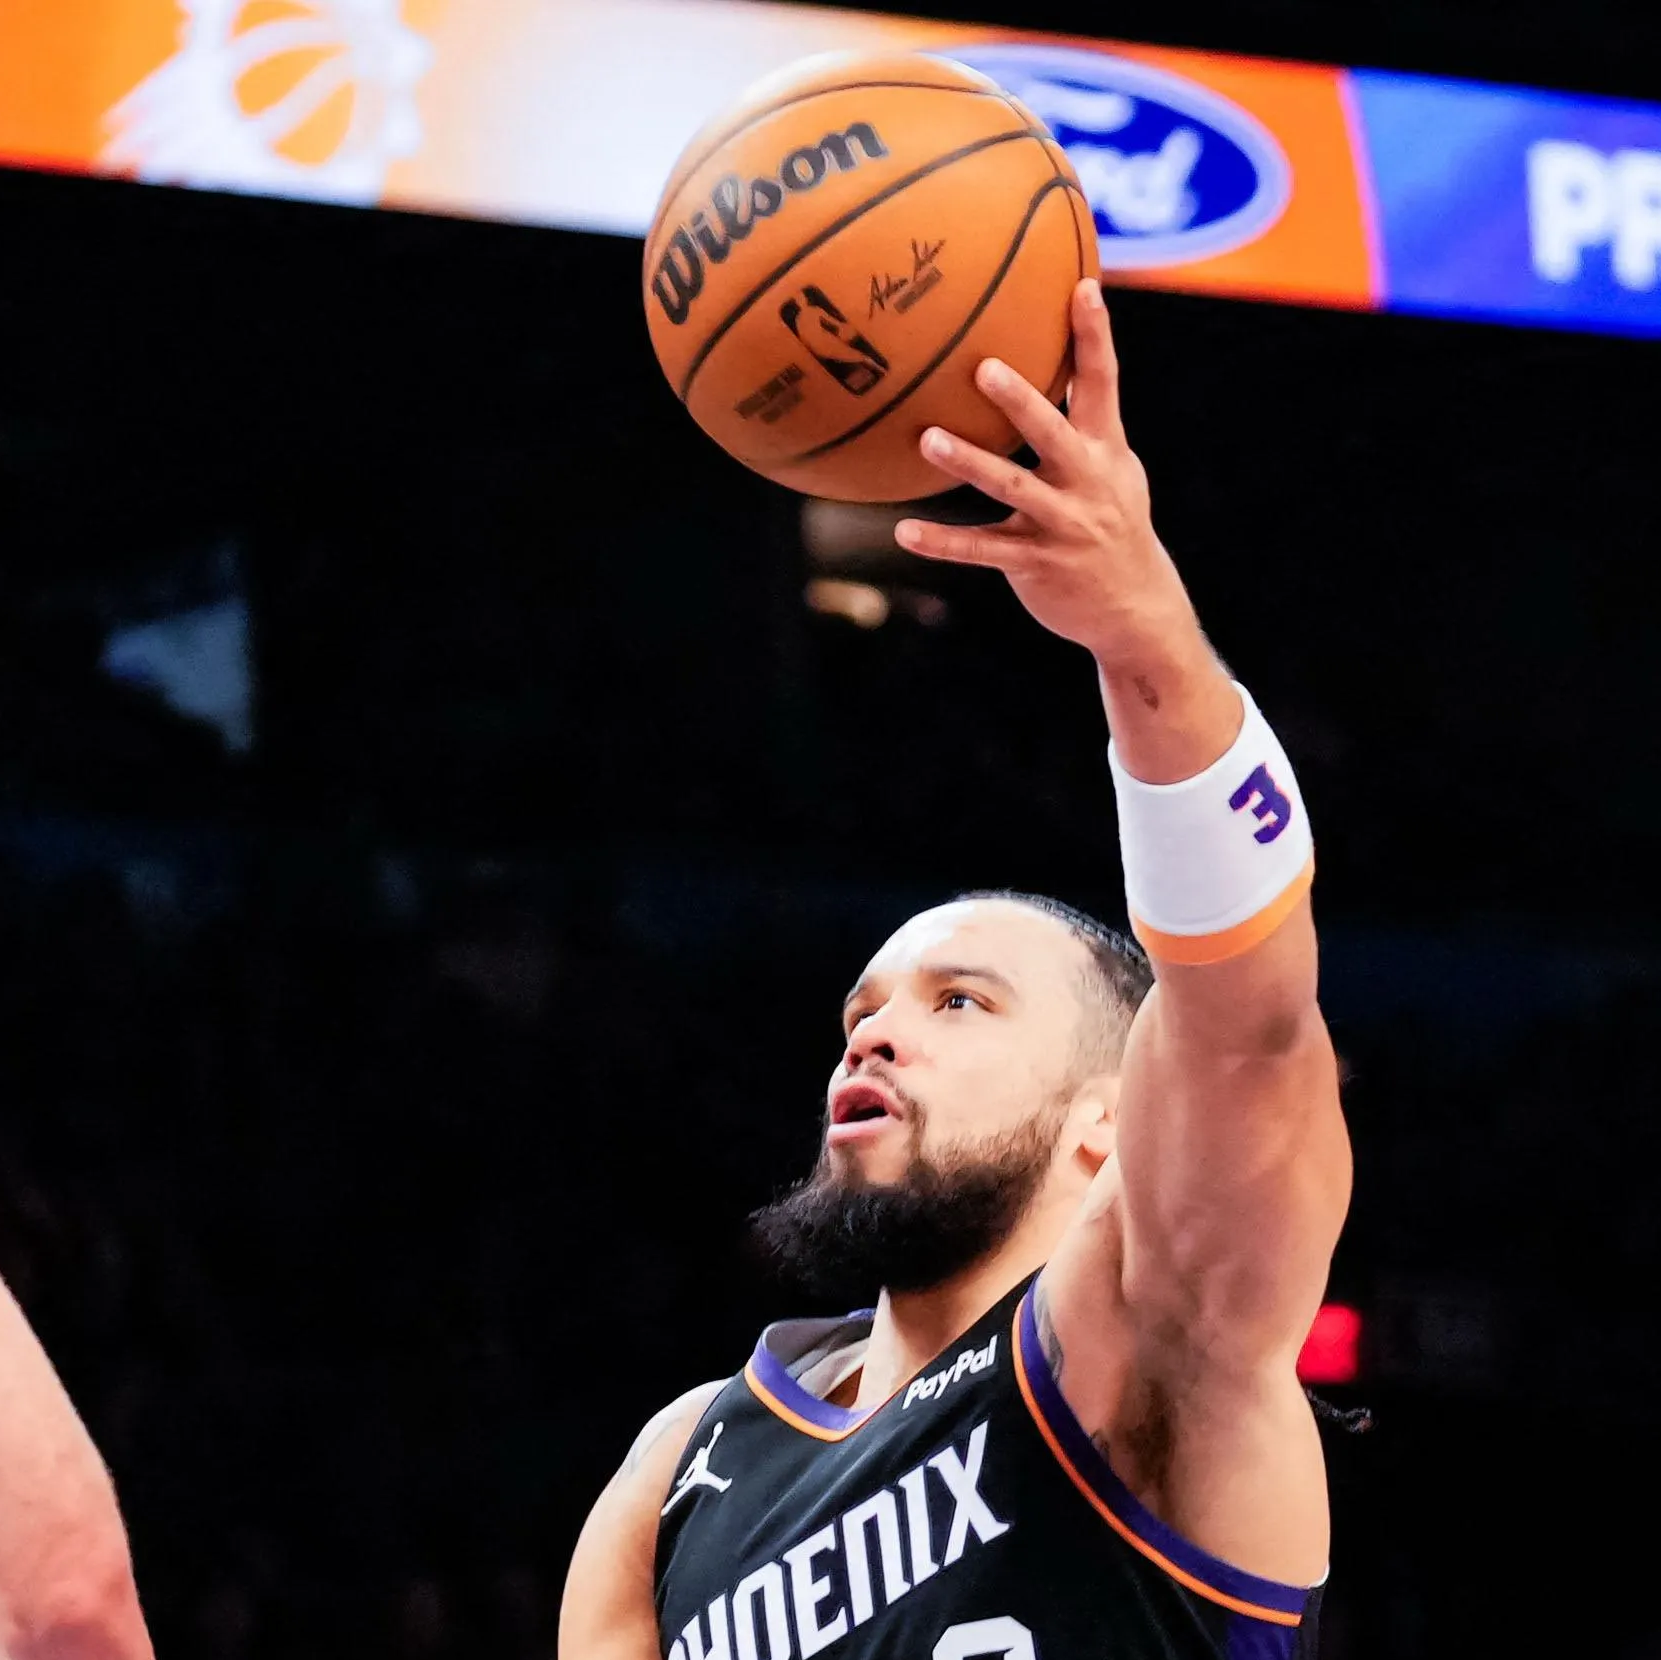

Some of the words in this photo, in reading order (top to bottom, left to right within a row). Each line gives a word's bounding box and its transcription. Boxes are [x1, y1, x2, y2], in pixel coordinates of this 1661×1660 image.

[651, 120, 890, 326] Wilson
[1228, 762, 1291, 844] 3
[902, 1334, 998, 1410] PayPal
